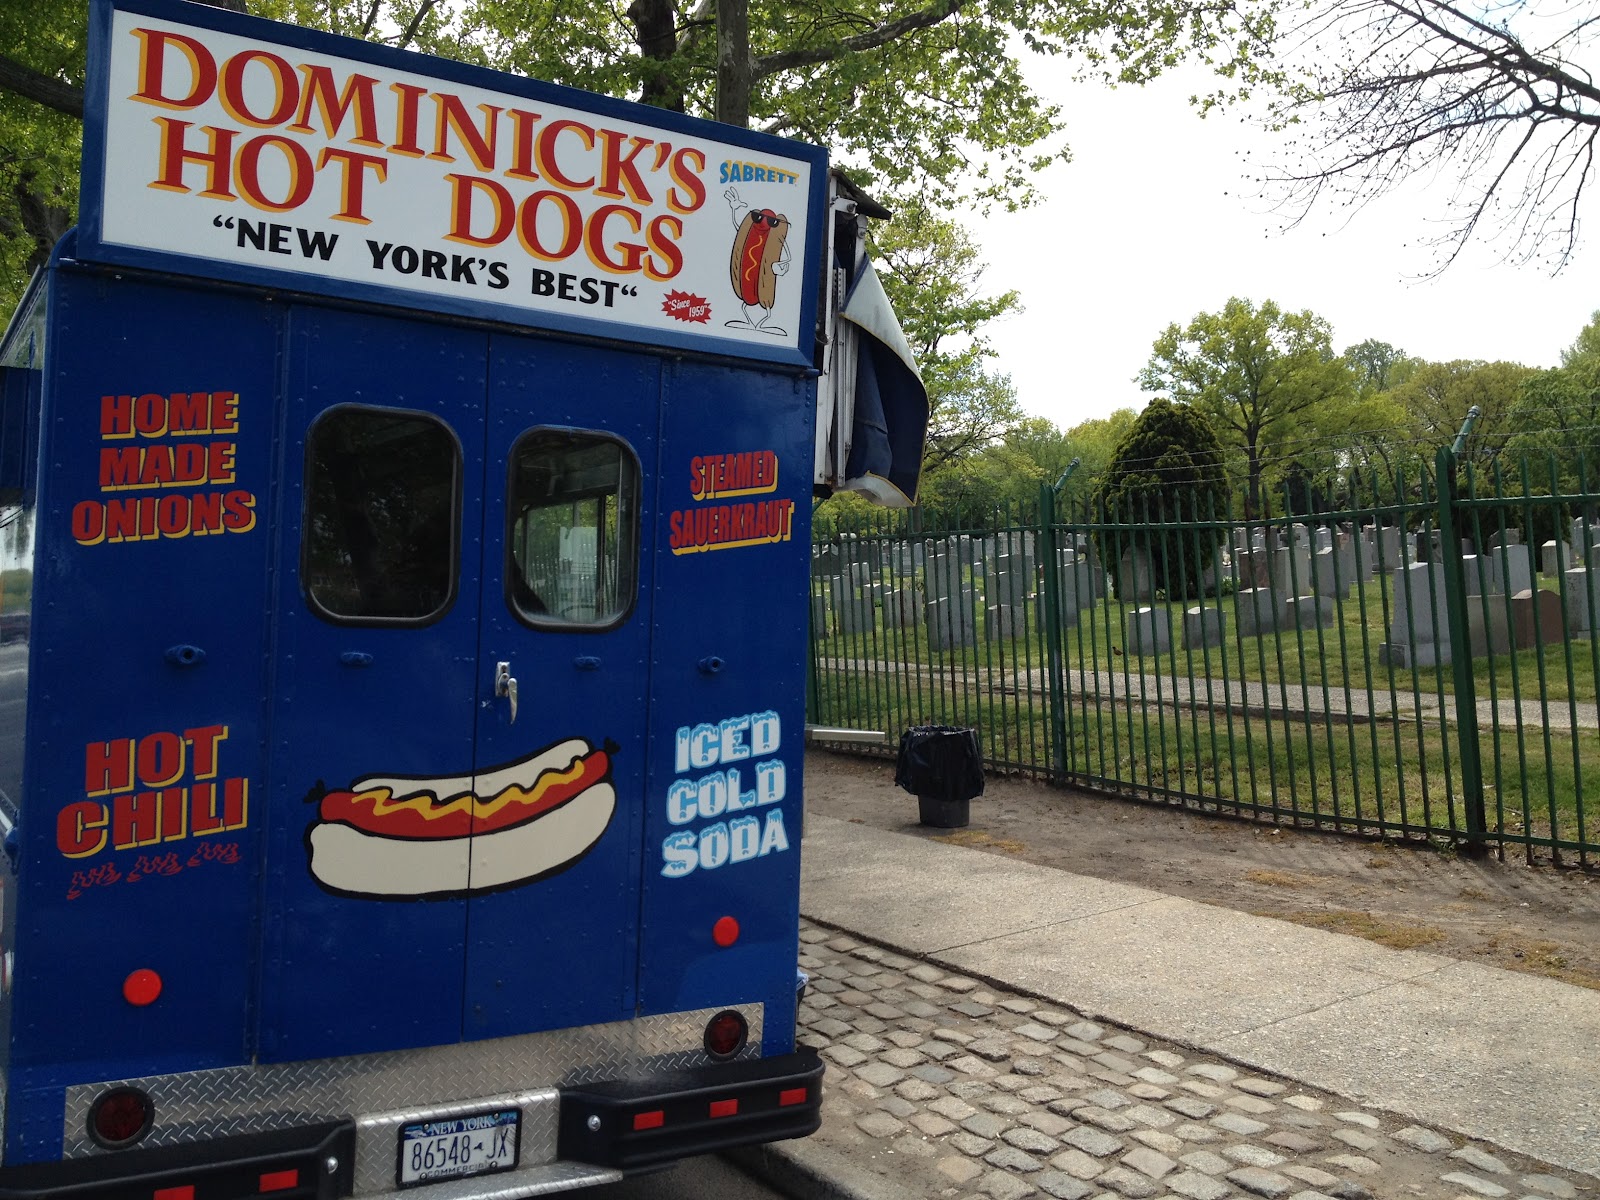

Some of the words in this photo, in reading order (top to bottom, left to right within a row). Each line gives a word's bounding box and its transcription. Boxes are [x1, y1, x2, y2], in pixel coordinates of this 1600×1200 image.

[129, 27, 707, 214] DOMINICK'S
[147, 116, 388, 226] HOT
[442, 173, 684, 282] DOGS
[719, 159, 800, 186] SABRETT
[367, 240, 510, 291] YORK'S
[100, 391, 239, 440] HOME
[99, 441, 236, 492] MADE
[690, 450, 779, 501] STEAMED
[71, 490, 256, 546] ONIONS
[669, 498, 795, 556] SAUERKRAUT
[85, 724, 229, 798] HOT
[675, 709, 781, 774] ICED
[56, 777, 248, 859] CHILI
[666, 758, 786, 826] COLD
[660, 808, 789, 878] SODA
[411, 1134, 471, 1172] 86548
[430, 1121, 459, 1136] NEW
[462, 1116, 493, 1131] YORK
